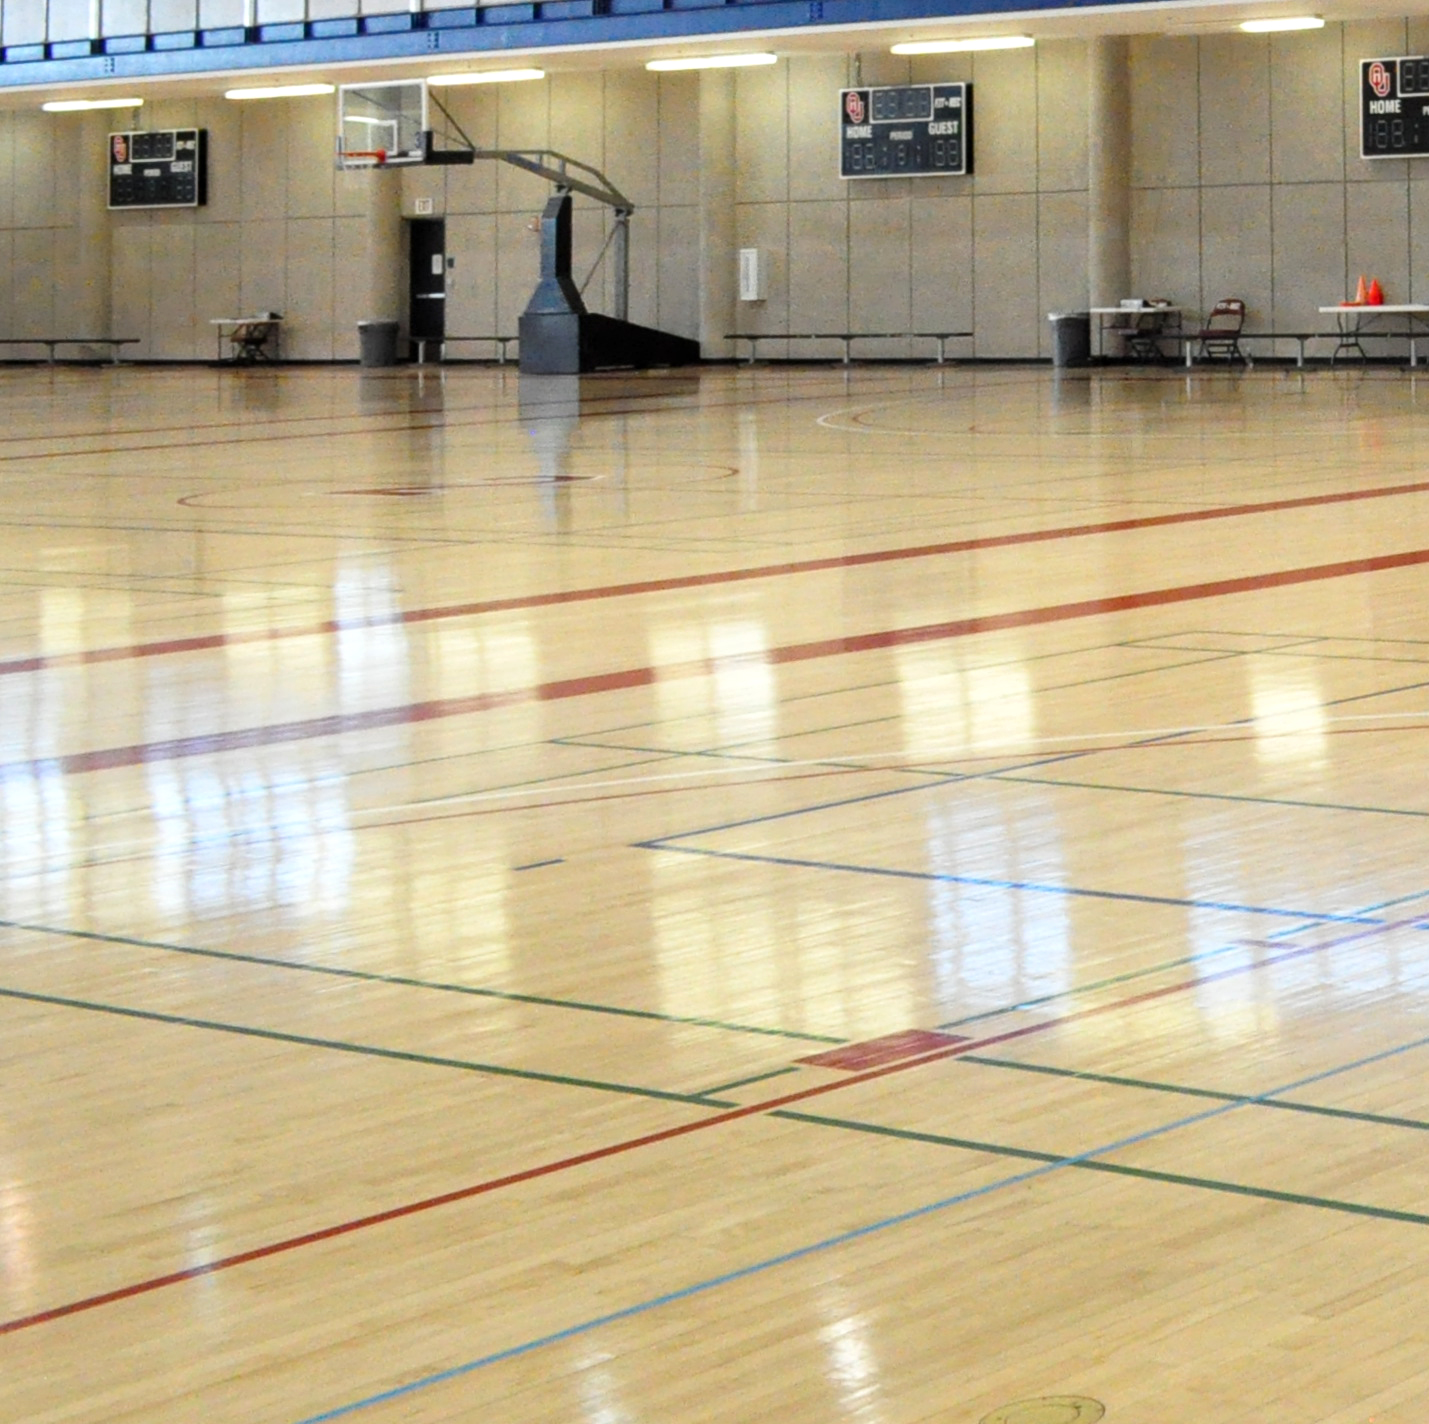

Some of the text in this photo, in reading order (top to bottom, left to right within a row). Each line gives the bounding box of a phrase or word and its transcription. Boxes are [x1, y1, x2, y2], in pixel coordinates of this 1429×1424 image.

[1369, 99, 1402, 115] HOME
[846, 125, 873, 138] HOME
[928, 121, 959, 135] GUEST
